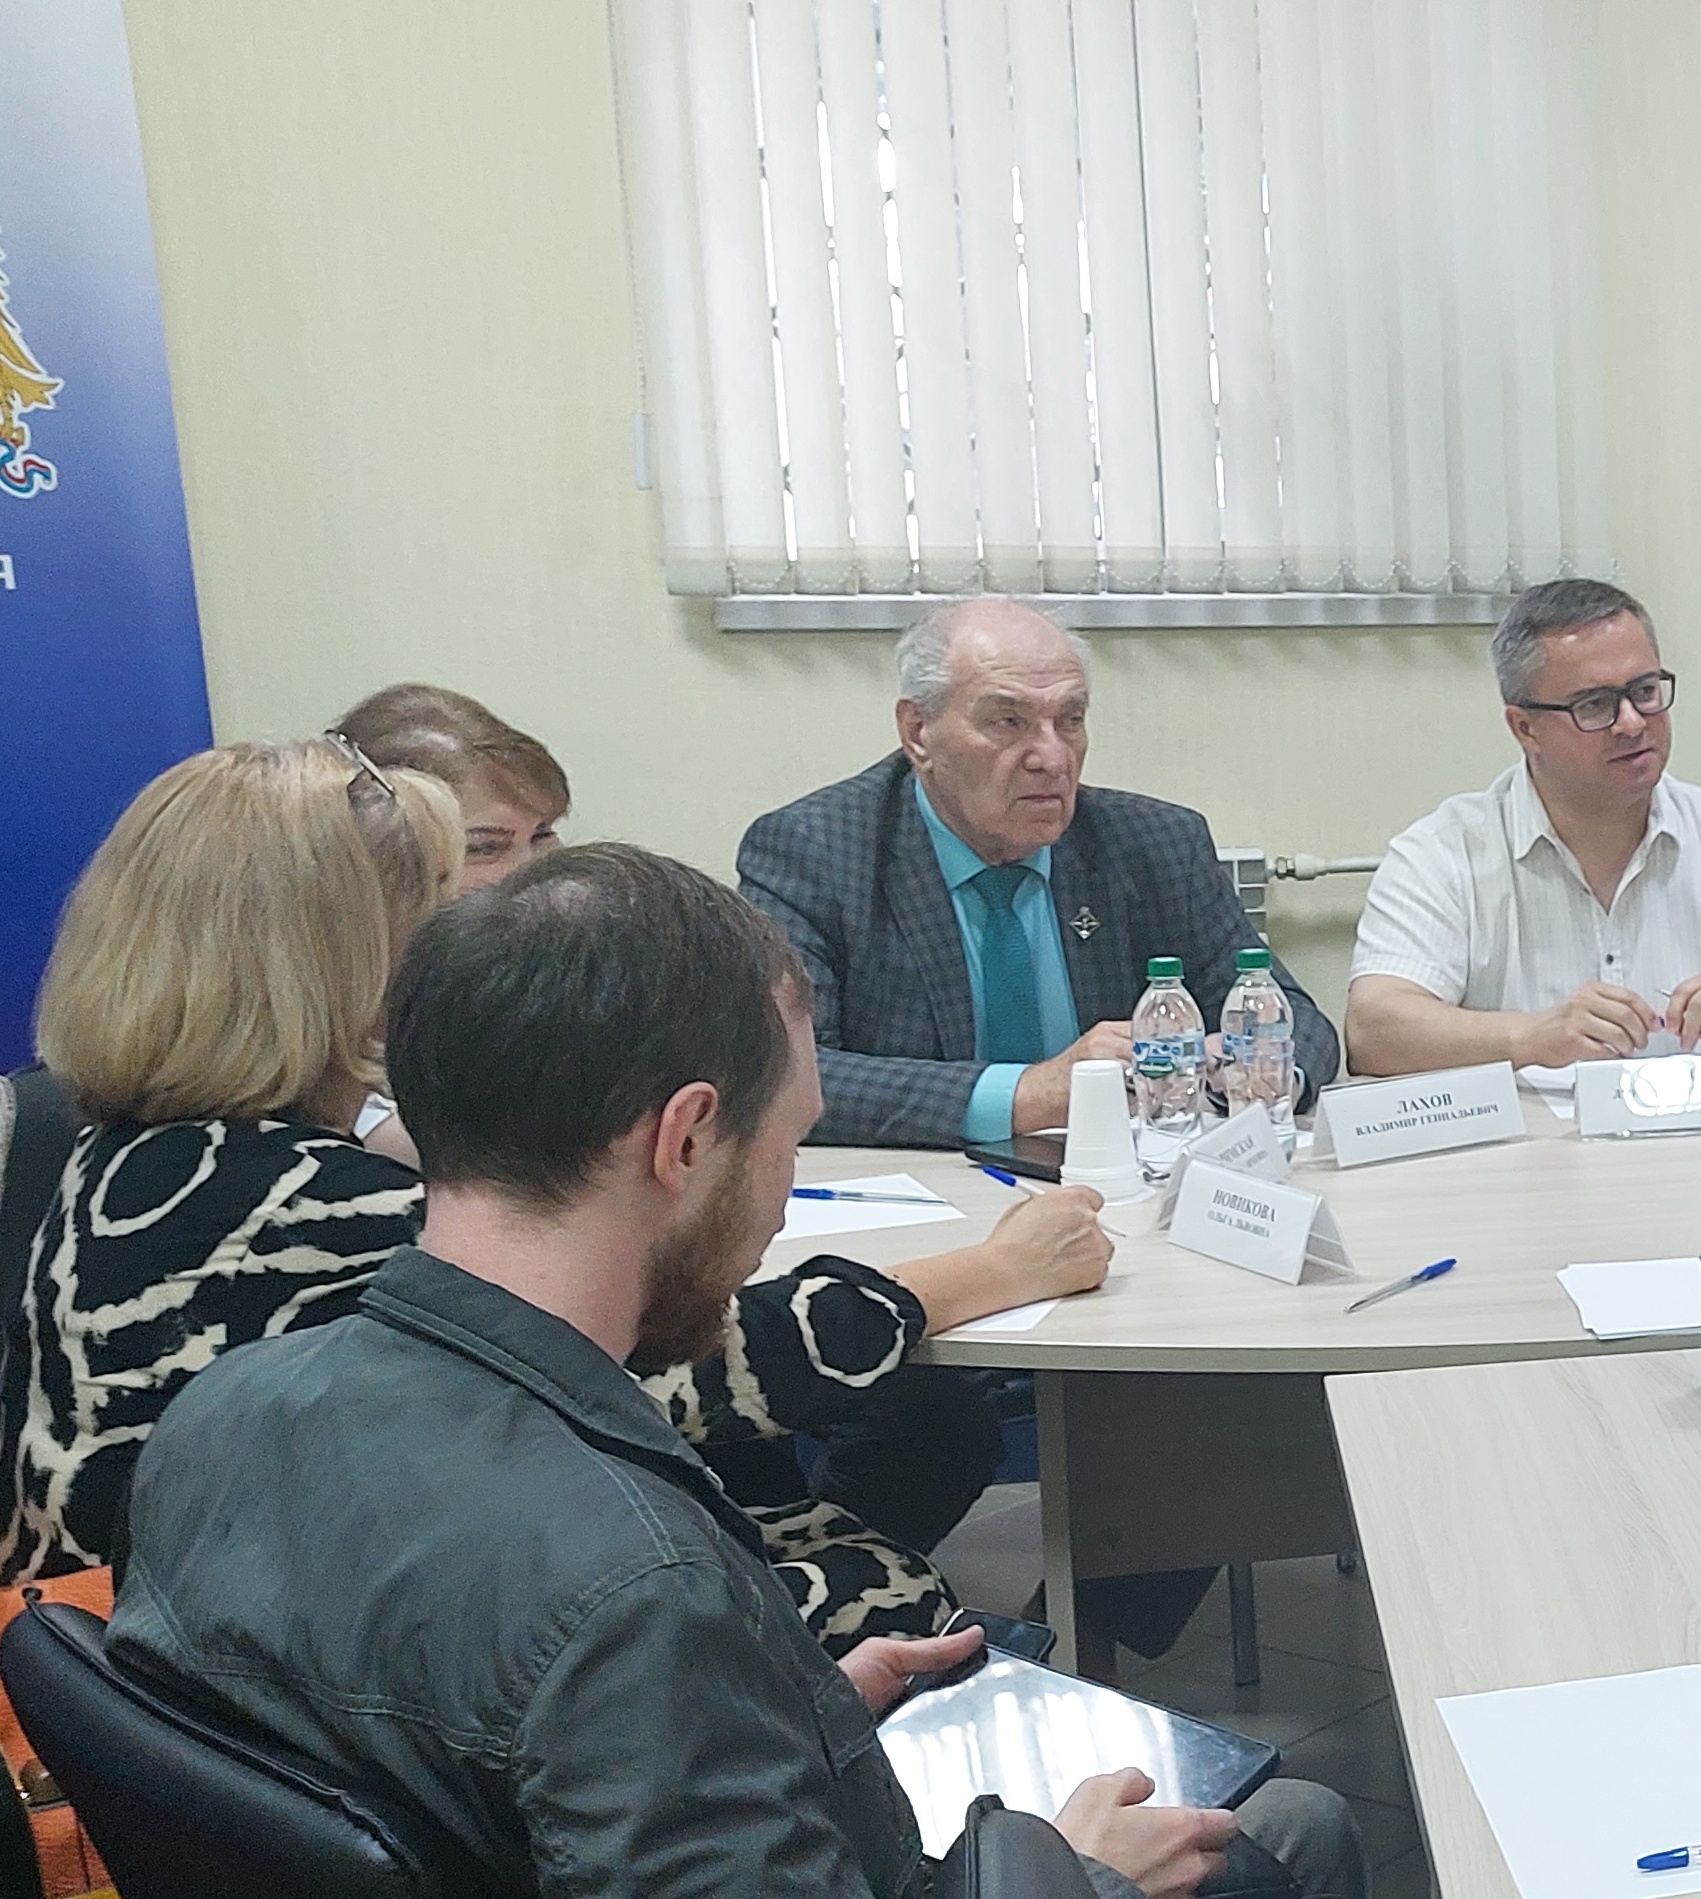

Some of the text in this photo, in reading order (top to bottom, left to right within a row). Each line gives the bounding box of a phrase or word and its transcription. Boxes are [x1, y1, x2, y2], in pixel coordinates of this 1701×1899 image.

[1397, 1093, 1453, 1114] ЛАХОВ
[1355, 1104, 1499, 1136] ВЛАДИМИР ГЕННАДЬЕВИЧ
[1212, 1189, 1275, 1222] НОВИКОВА
